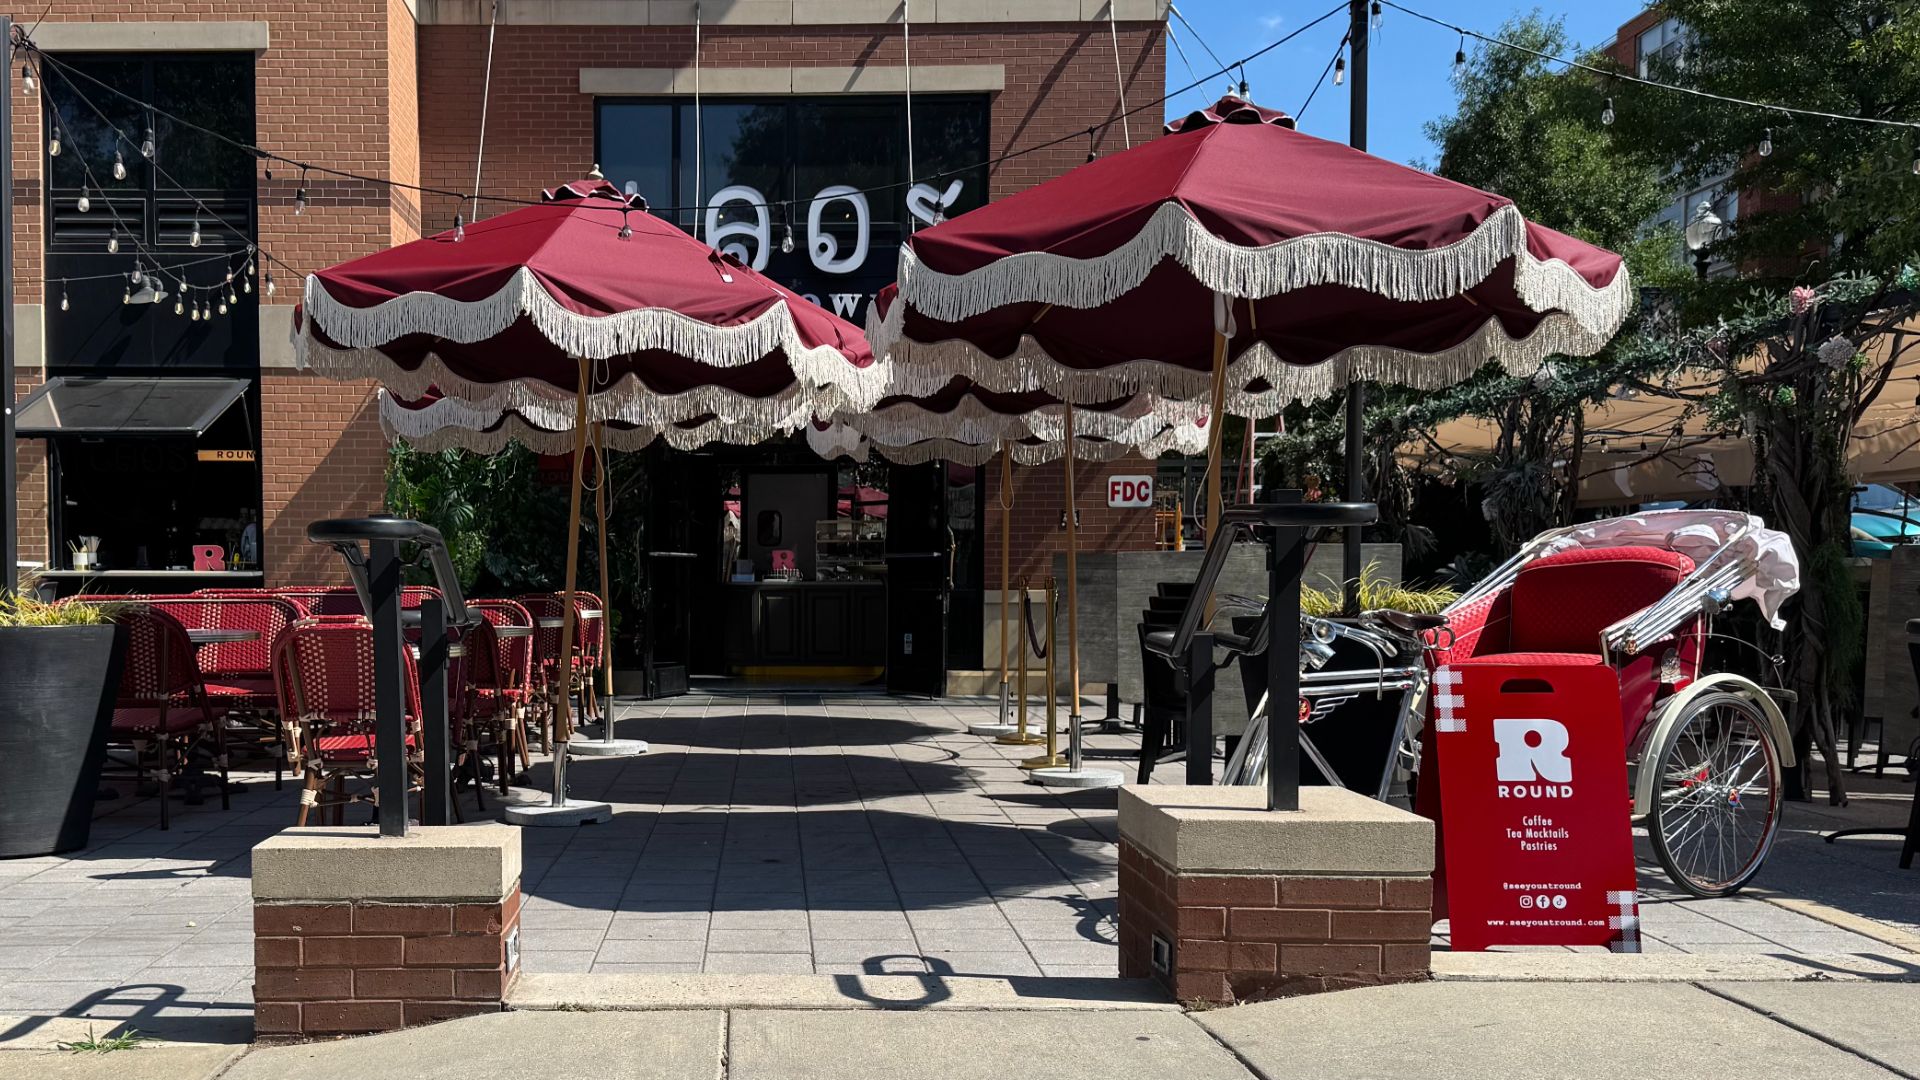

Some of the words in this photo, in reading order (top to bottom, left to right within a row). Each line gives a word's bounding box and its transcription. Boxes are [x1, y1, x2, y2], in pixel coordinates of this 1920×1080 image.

[1110, 481, 1150, 502] FDC
[193, 545, 226, 571] R
[1493, 718, 1573, 783] R
[1498, 785, 1573, 798] ROUND
[1522, 815, 1553, 826] Coffee
[1506, 828, 1522, 838] Tea
[1525, 827, 1569, 838] Mocktails
[1520, 840, 1558, 851] Pastries
[1503, 882, 1582, 891] @seeyouatround
[1487, 919, 1605, 927] www.seeyouatround.com
